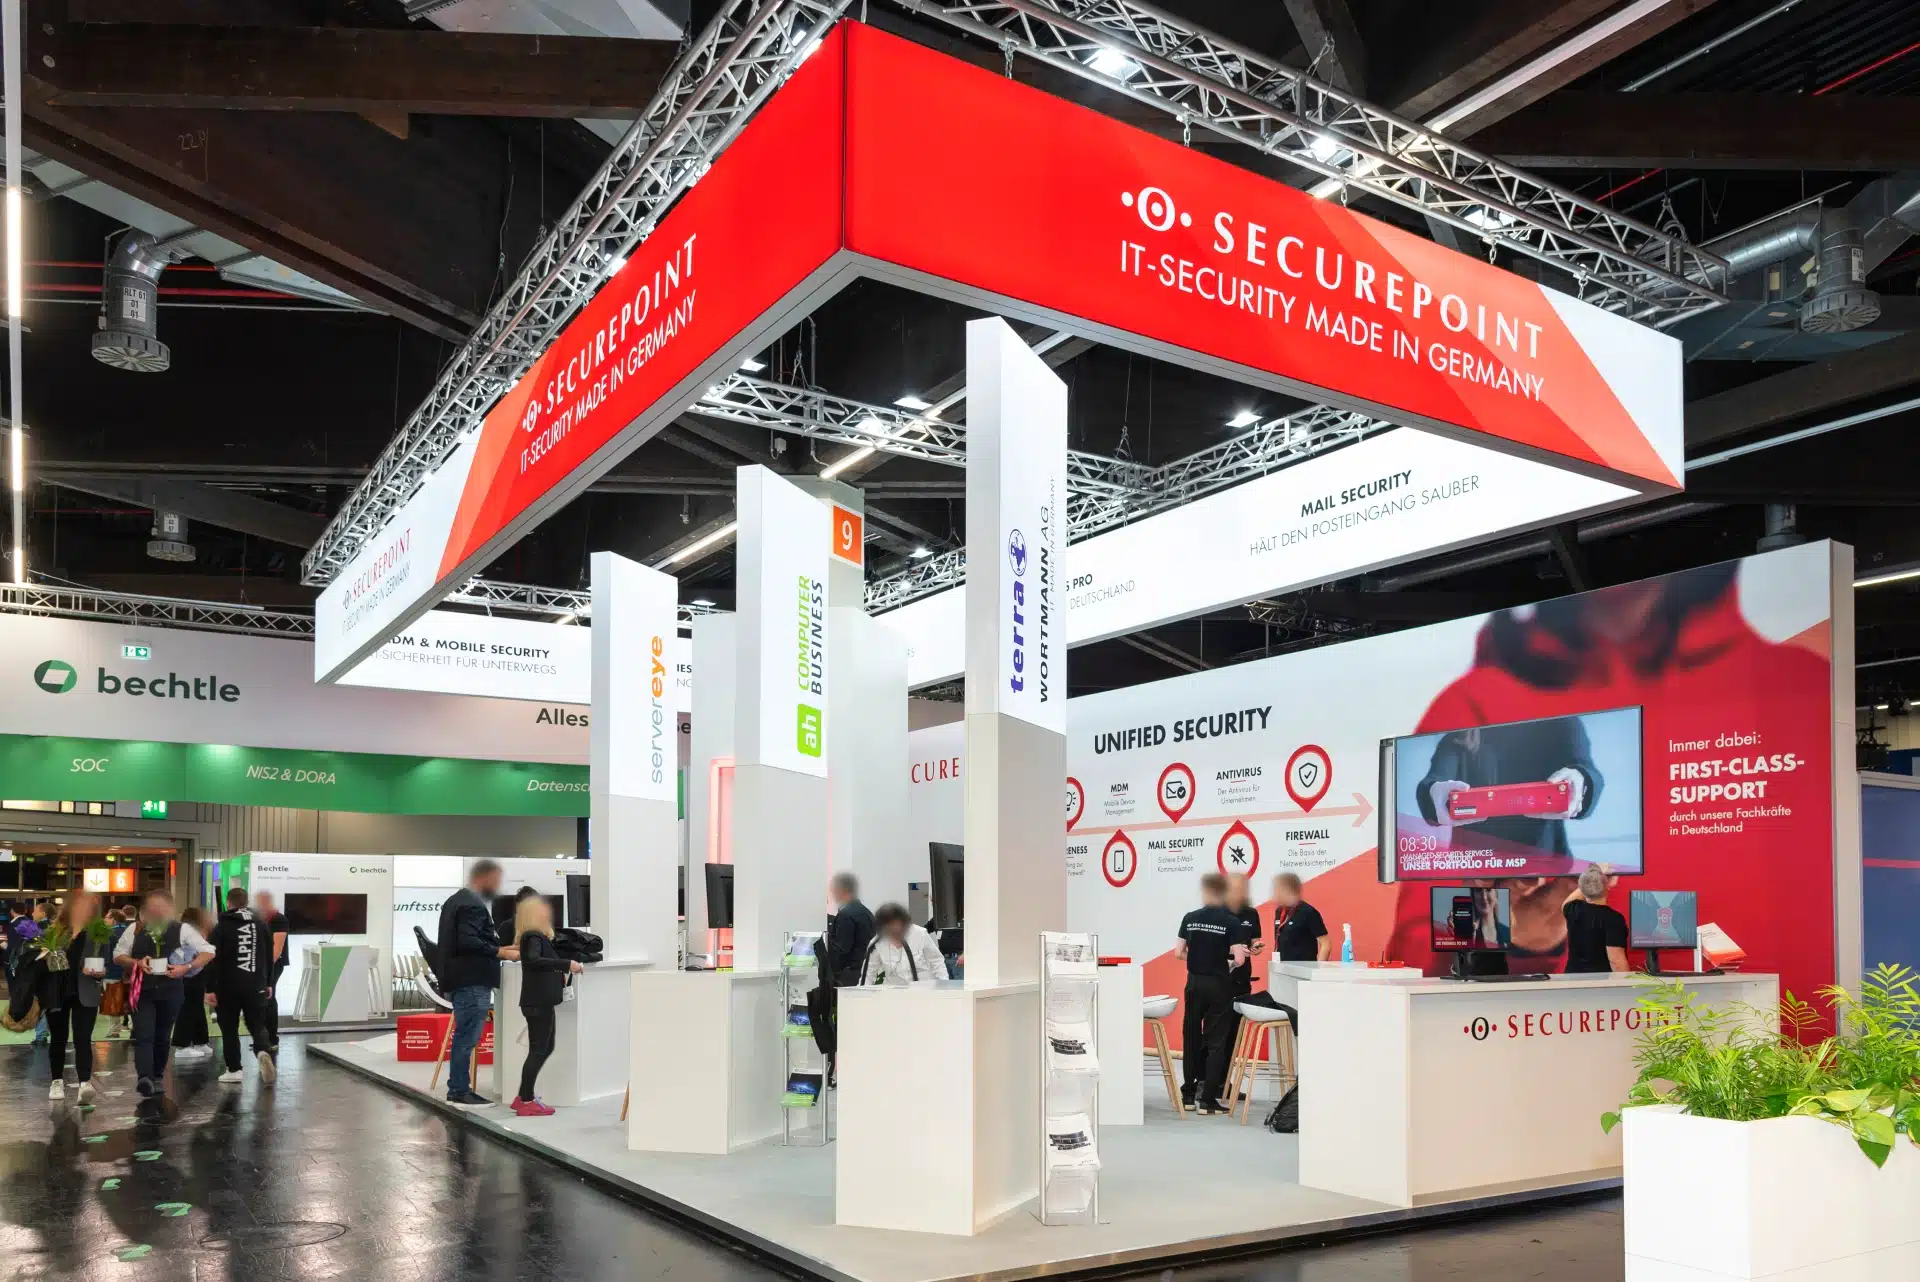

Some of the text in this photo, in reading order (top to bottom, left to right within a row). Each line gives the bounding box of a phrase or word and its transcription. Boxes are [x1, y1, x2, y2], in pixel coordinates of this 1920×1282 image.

[1213, 211, 1543, 359] SECUREPOINT
[546, 233, 697, 415] SECUREPOINT
[1121, 239, 1544, 401] IT-SECURITY MADE IN GERMANY
[520, 289, 697, 475] IT-SECURITY MADE IN GERMANY
[1301, 469, 1412, 518] MAIL SECURITY
[1249, 474, 1480, 556] HÄLT DEN POSTEINGANG SAUBER
[842, 519, 853, 551] 9
[352, 528, 411, 603] SECUREPOINT
[1069, 579, 1136, 610] DEUTSCHLAND
[1073, 573, 1093, 590] PRO
[1040, 505, 1049, 703] WORTMANN AG
[798, 575, 810, 692] COMPUTER
[811, 579, 823, 696] BUSINESS
[1010, 580, 1025, 694] terra
[420, 638, 430, 648] &
[435, 639, 486, 653] MOBILE
[491, 644, 550, 659] SECURITY
[456, 655, 478, 669] FÜR
[482, 659, 557, 675] UNTERWEGS
[98, 667, 241, 703] bechtle
[536, 707, 589, 727] Alles
[651, 635, 665, 784] servereye
[802, 714, 817, 749] ah
[1094, 705, 1272, 755] UNIFIED SECURITY
[1669, 731, 1762, 753] Immer dabei:
[70, 758, 109, 773] SOC
[246, 765, 336, 785] NIS2 & DORA
[1216, 766, 1262, 781] ANTIVIRUS
[1669, 753, 1805, 781] FIRST-CLASS-
[1110, 783, 1129, 793] MDM
[1669, 780, 1768, 804] SUPPORT
[1669, 804, 1792, 822] durch unsere Fachkräfte
[1285, 829, 1330, 842] FIREWALL
[1669, 820, 1744, 836] in Deutschland
[1148, 837, 1205, 850] MAIL SECURITY
[1288, 848, 1298, 857] Die
[1400, 835, 1437, 852] 08:30
[1464, 849, 1493, 857] SERVICES
[1403, 861, 1431, 871] UNSER
[1433, 859, 1482, 870] PORTFOLIO
[1485, 857, 1502, 868] FÜR
[1505, 857, 1527, 868] MSP
[116, 872, 127, 889] 6
[236, 923, 252, 973] ALPHA
